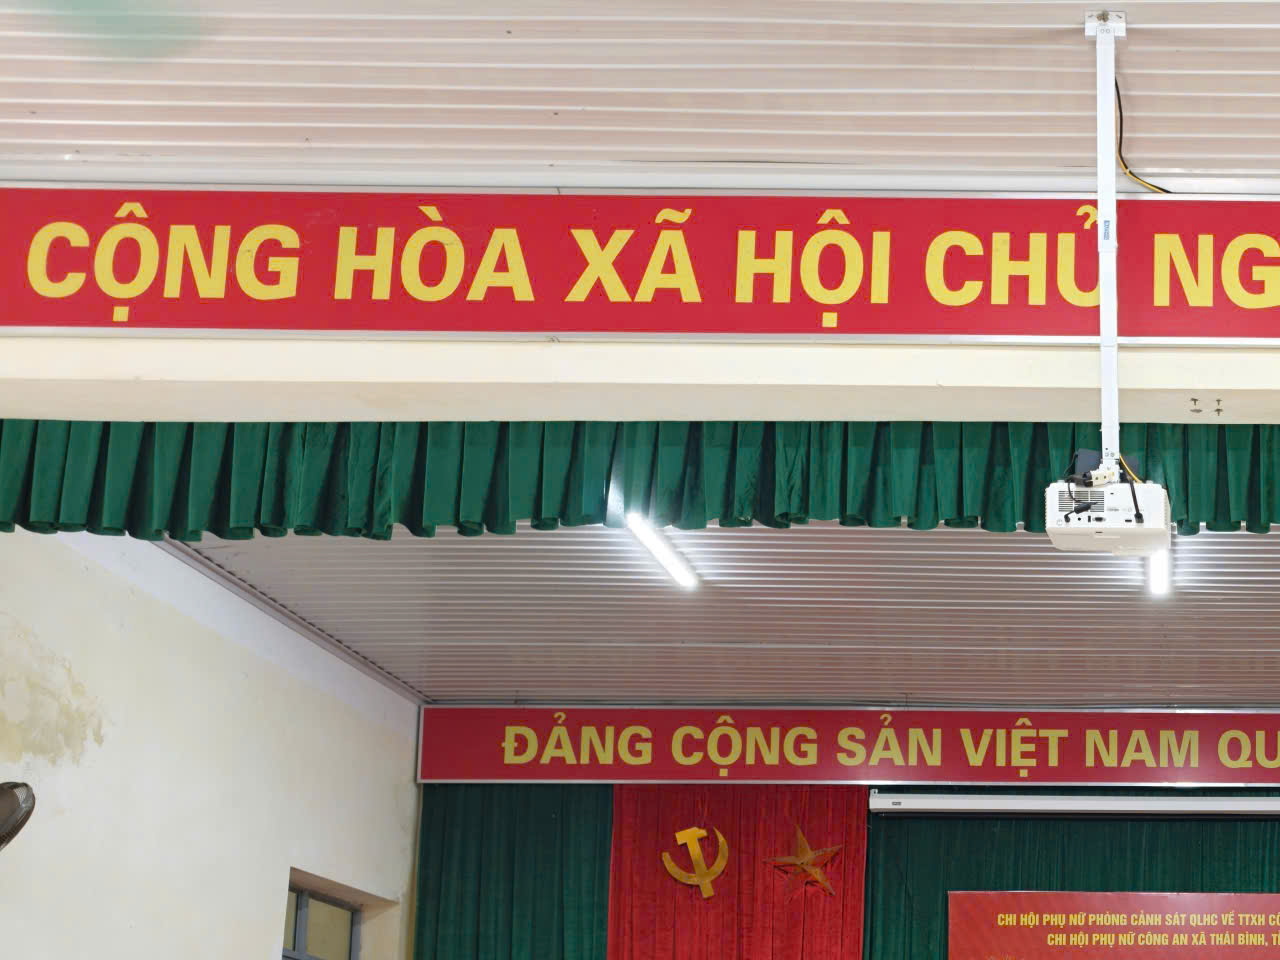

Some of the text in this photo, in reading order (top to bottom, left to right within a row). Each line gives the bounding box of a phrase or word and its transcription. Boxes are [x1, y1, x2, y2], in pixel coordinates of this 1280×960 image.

[26, 203, 300, 322] CỘNG
[333, 205, 534, 303] HÒA
[564, 208, 703, 304] XÃ
[735, 208, 892, 328] HỘI
[924, 204, 1100, 308] CHỦ
[500, 712, 653, 766] ĐẢNG
[671, 714, 818, 777] CỘNG
[836, 713, 942, 767] SẢN
[960, 717, 1069, 777] VIỆT
[1085, 728, 1199, 769] NAM
[997, 913, 1017, 926] CHI
[1019, 912, 1040, 928] HỘI
[1043, 914, 1066, 928] PHỤ
[1068, 911, 1087, 926] NỮ
[1088, 911, 1128, 926] PHÒNG
[1130, 910, 1162, 926] CẢNH
[1165, 912, 1187, 926] SÁT
[1189, 914, 1218, 927] QLHC
[1237, 914, 1266, 926] TTXH
[1047, 933, 1067, 946] CHI
[1069, 931, 1089, 948] HỘI
[1092, 933, 1116, 948] PHỤ
[1118, 931, 1136, 946] NỮ
[1137, 931, 1169, 946] CÔNG
[1171, 933, 1189, 946] AN
[1191, 931, 1207, 946] XÃ
[1209, 930, 1235, 946] THÁI
[1237, 930, 1269, 947] BÌNH,
